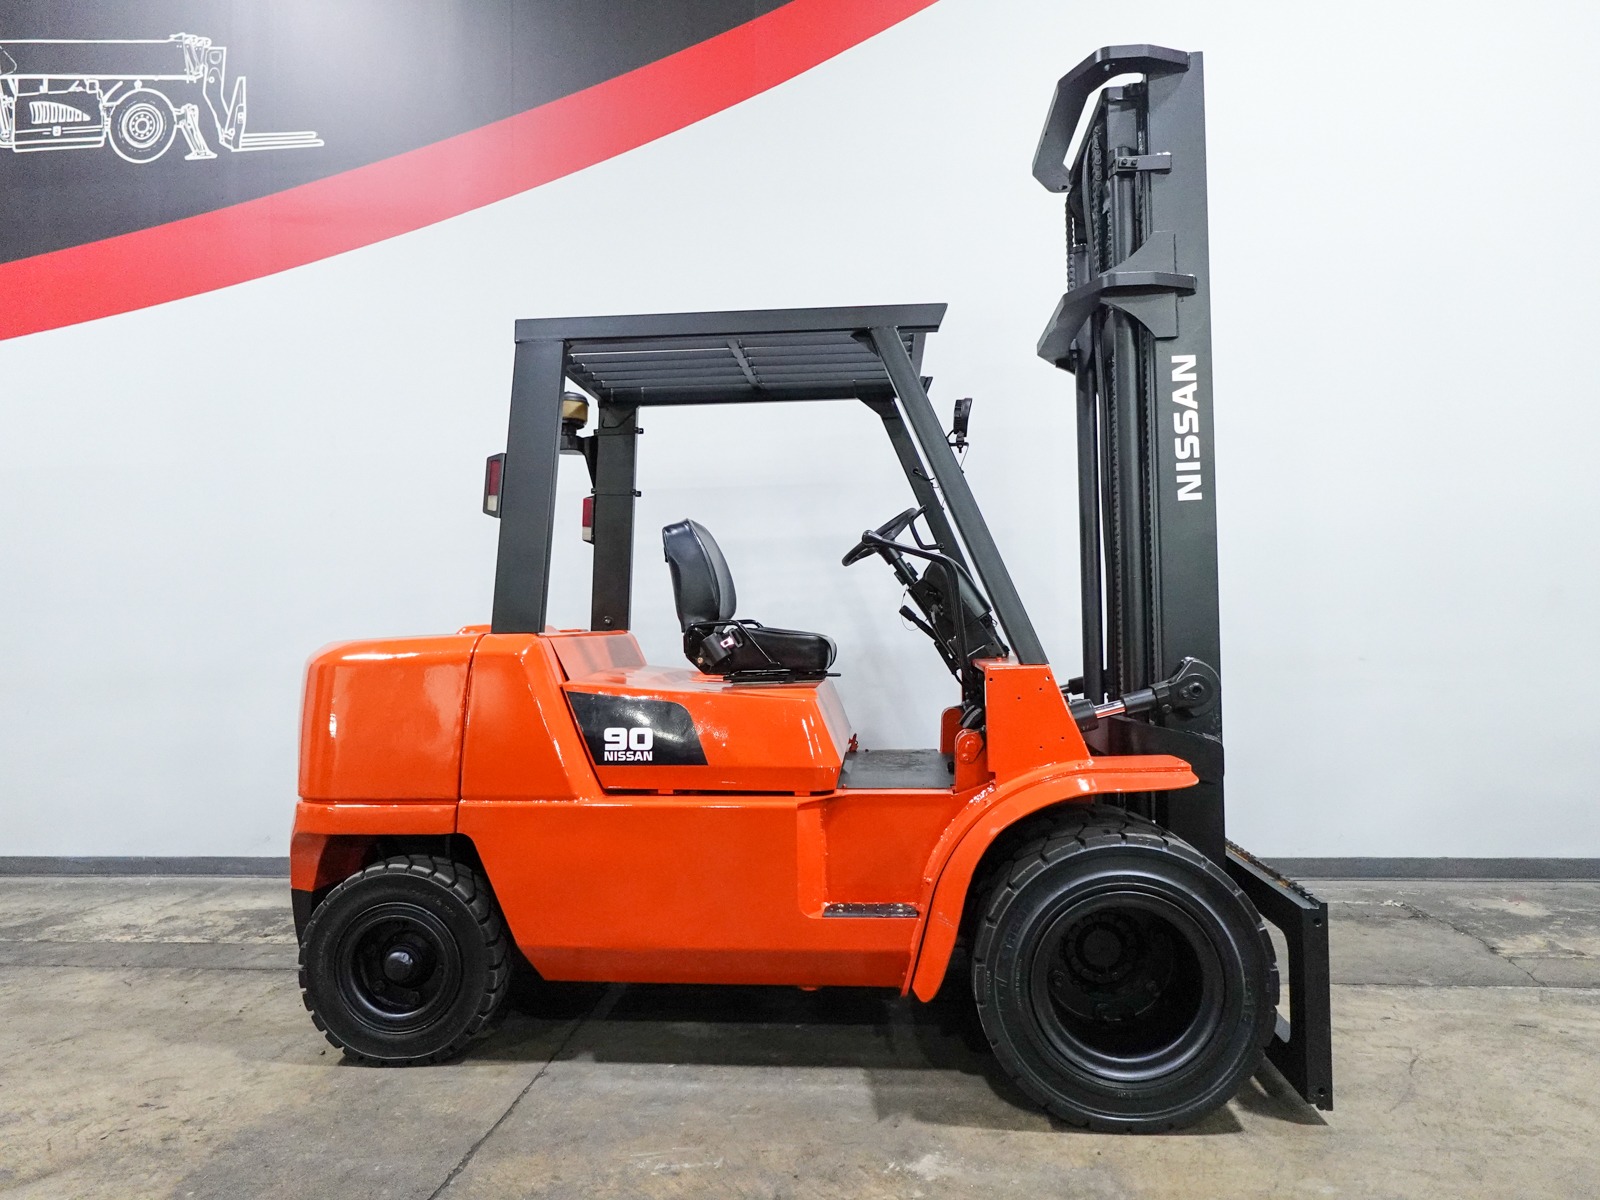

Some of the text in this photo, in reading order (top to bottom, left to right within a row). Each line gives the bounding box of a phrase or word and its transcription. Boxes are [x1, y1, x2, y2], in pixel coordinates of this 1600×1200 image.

[1171, 354, 1203, 501] NISSAN
[603, 727, 654, 751] 90
[603, 751, 653, 762] NISSAN
